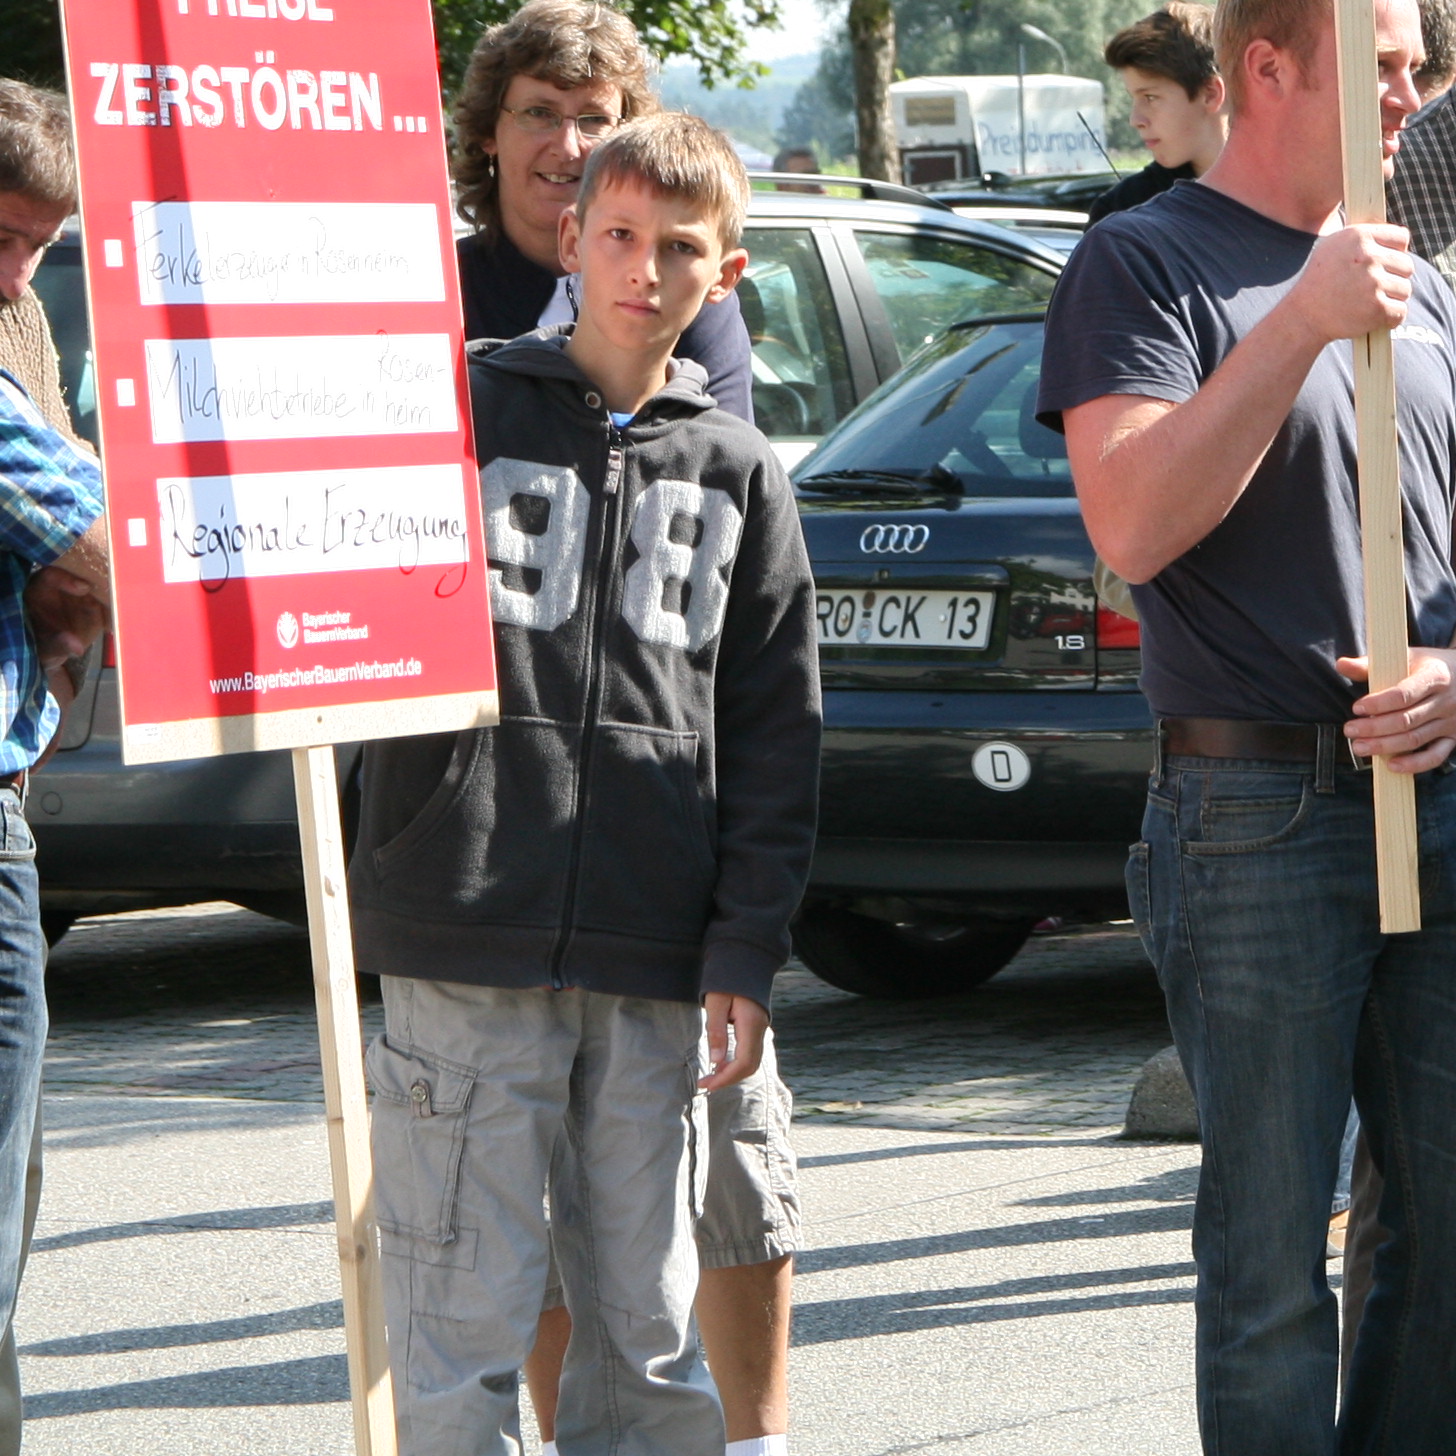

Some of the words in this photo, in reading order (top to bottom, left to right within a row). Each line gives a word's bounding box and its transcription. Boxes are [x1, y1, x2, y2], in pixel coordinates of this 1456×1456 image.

[978, 120, 1105, 156] Preidumping
[161, 482, 312, 592] Regionale
[320, 484, 468, 598] Erzeugung
[302, 611, 350, 627] Bayerischer
[303, 624, 368, 644] BauernVerband
[879, 596, 927, 639] CK
[947, 597, 981, 640] 13
[209, 658, 422, 696] www.BayerischerBauernVerband.de
[991, 751, 1012, 783] D
